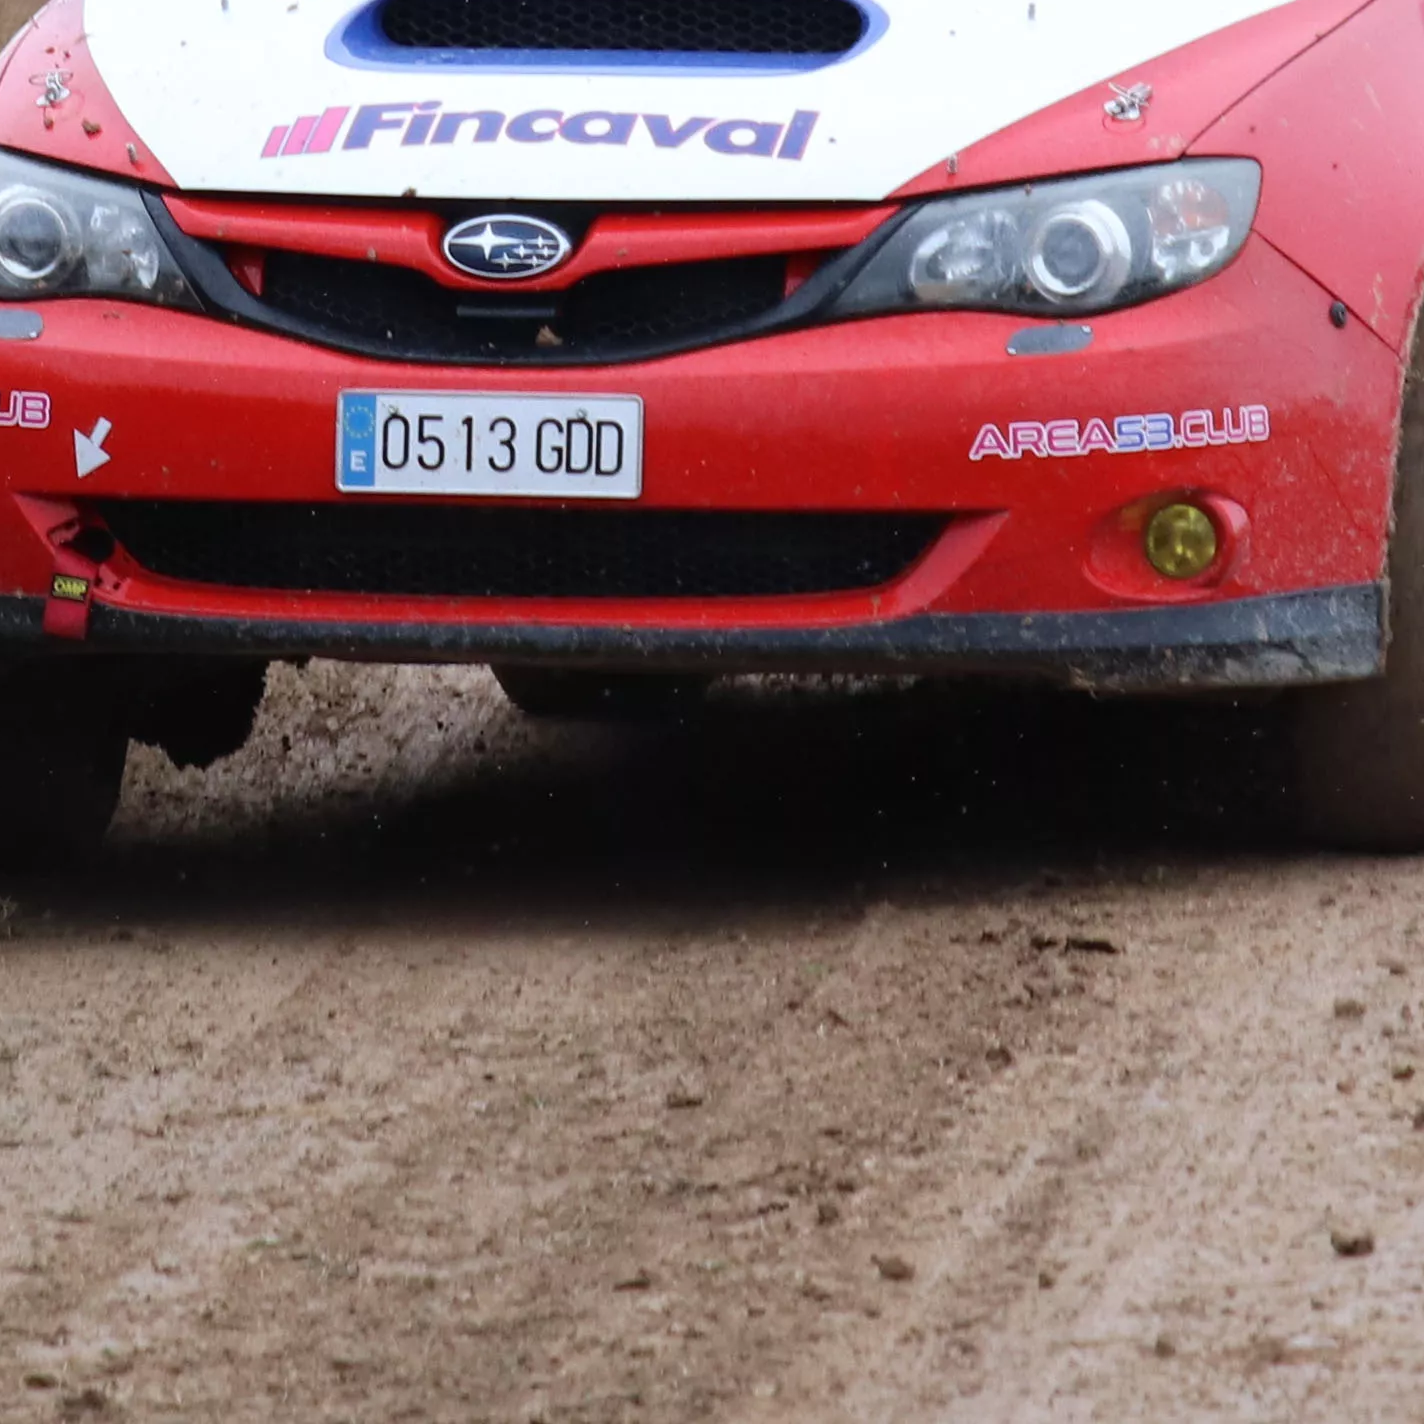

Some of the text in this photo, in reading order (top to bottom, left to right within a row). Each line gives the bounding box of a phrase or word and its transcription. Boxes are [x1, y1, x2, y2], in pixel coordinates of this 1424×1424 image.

[342, 100, 820, 161] Fincaval
[349, 450, 367, 472] E
[382, 414, 624, 476] 0513 GDD
[969, 404, 1270, 461] AREA53.CLUB
